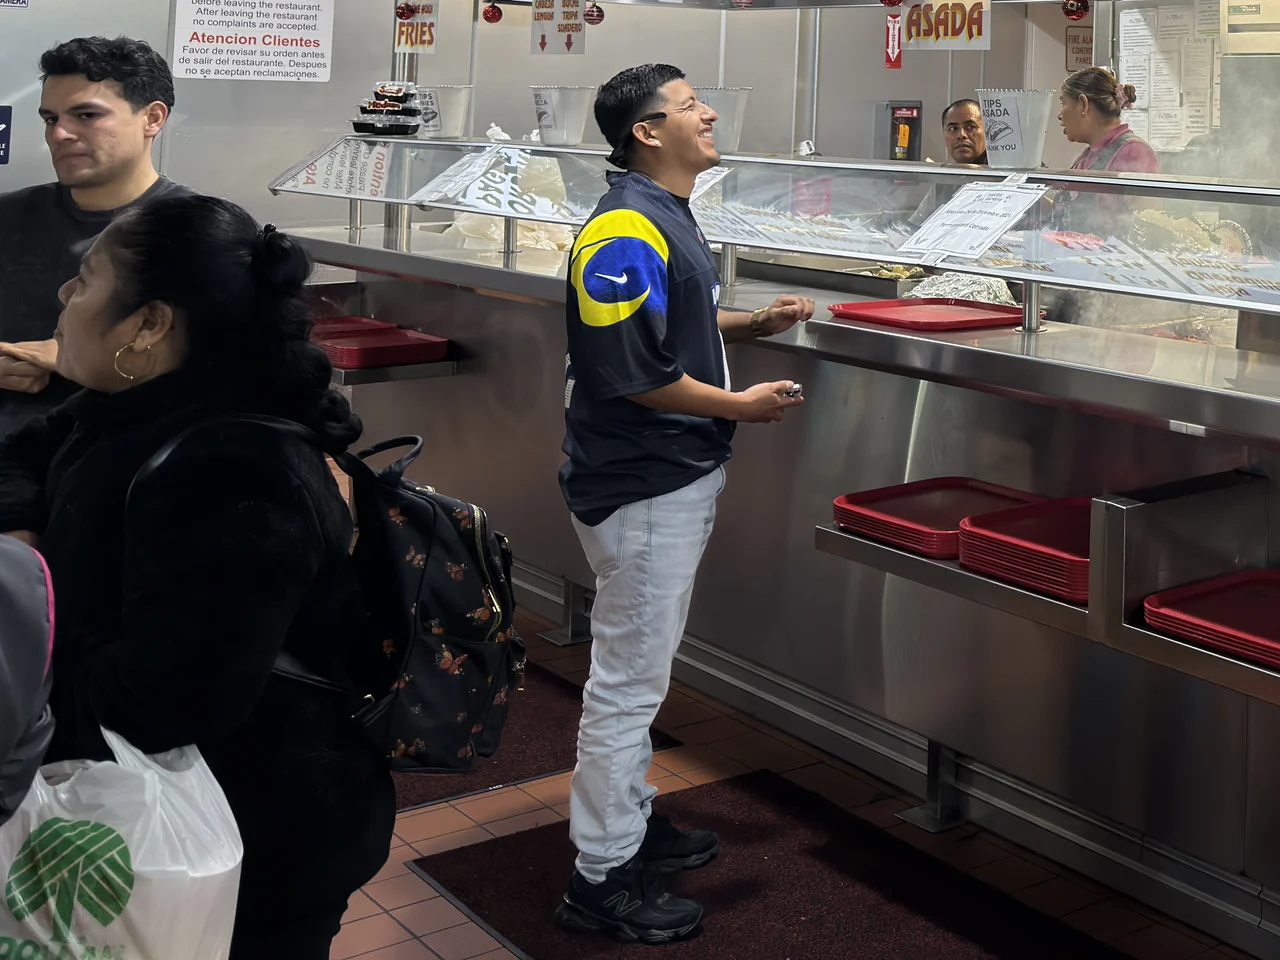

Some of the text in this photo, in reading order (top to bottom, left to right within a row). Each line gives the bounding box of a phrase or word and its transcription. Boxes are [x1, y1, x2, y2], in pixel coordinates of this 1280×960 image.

[224, 0, 256, 9] leaving
[259, 1, 273, 9] the
[275, 2, 322, 11] restaurant.
[196, 7, 317, 21] After leaving the restaurant
[207, 19, 256, 29] complaints
[276, 22, 319, 31] accepted.
[905, 1, 983, 43] ASADA
[189, 31, 320, 48] Atencion Clientes
[397, 21, 435, 49] FRIES
[182, 46, 209, 55] Favor
[212, 47, 224, 55] de
[226, 47, 257, 56] revisar
[273, 49, 298, 57] orden
[301, 51, 325, 59] antes
[178, 56, 327, 71] de salir del restaurante. Despues
[185, 67, 197, 75] no
[213, 68, 250, 78] aceptan
[253, 69, 319, 78] reclamaciones.
[983, 98, 1002, 108] TIPS
